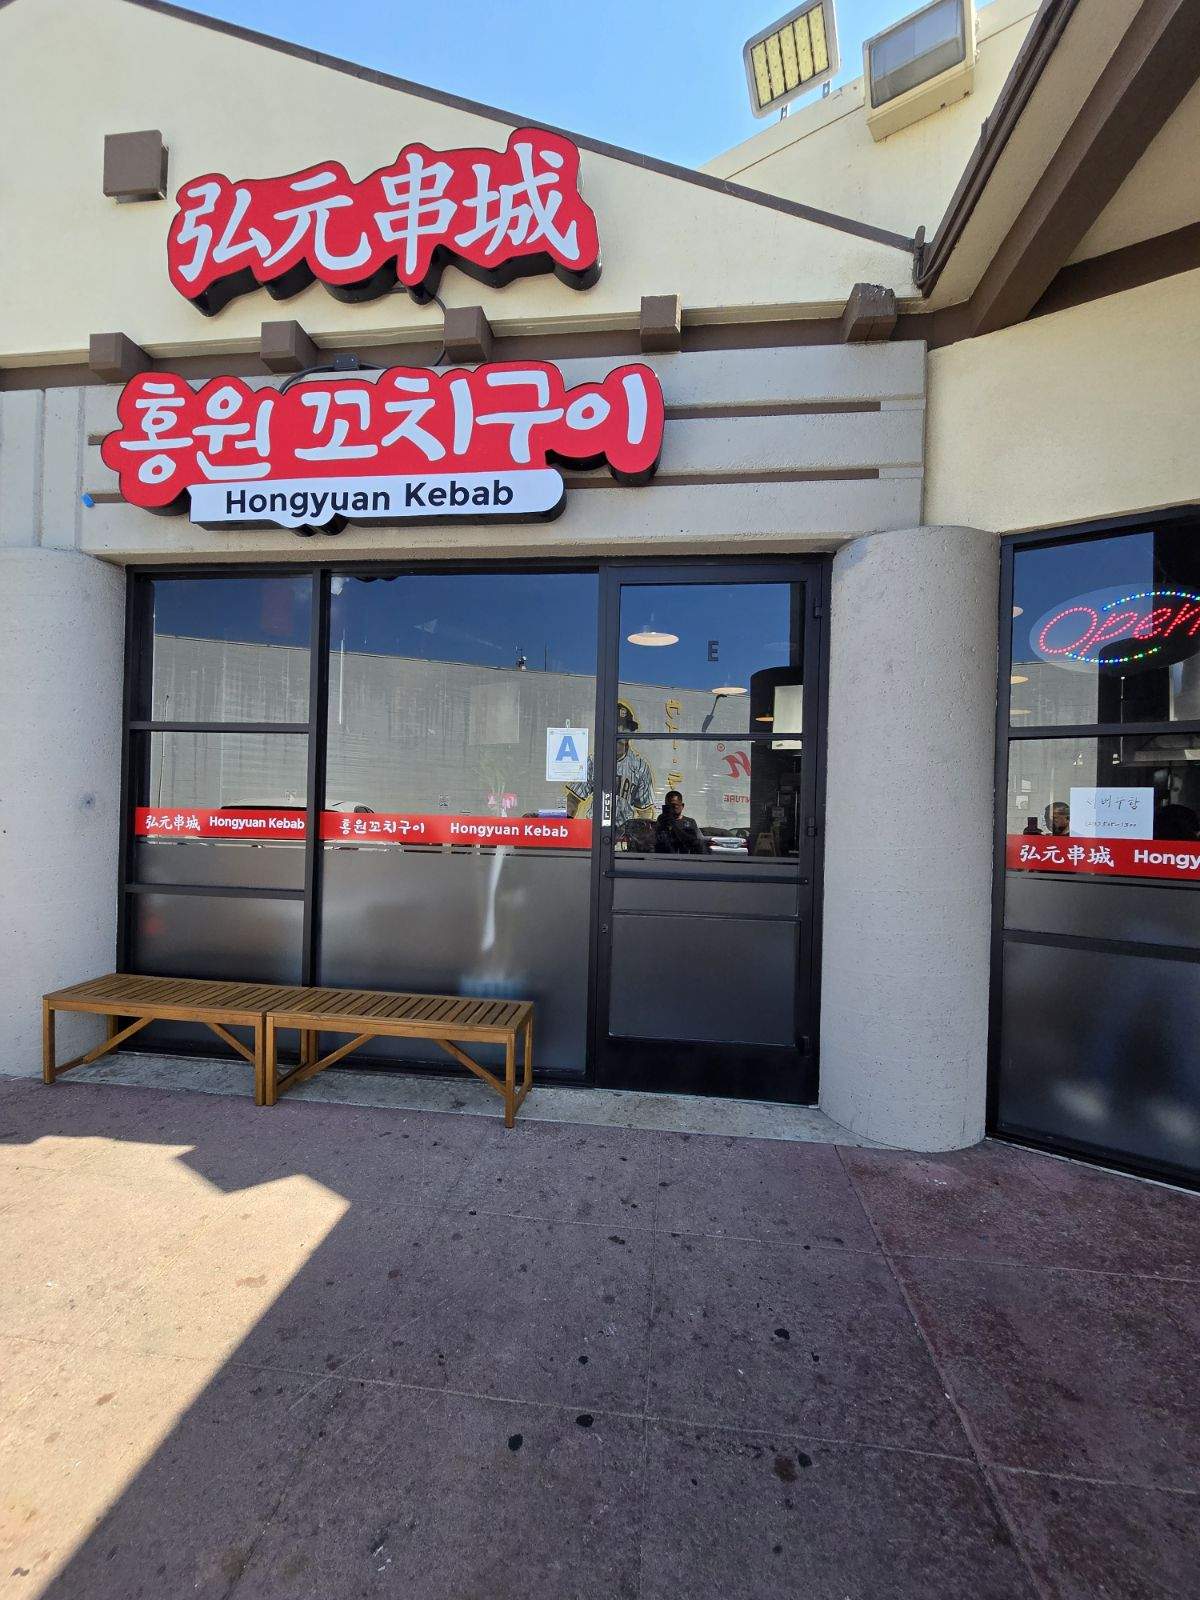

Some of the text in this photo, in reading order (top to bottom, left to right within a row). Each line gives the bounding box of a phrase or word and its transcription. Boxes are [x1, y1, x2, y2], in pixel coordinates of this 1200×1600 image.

[177, 142, 580, 283] 弘元串城
[226, 480, 514, 518] Hongyuan Kebab
[1039, 605, 1200, 657] Open
[707, 640, 720, 662] E
[556, 735, 580, 762] A
[146, 814, 200, 831] 弘元串城
[209, 816, 305, 830] Hongyuan Kebab
[450, 822, 569, 838] Hongyuan Kebab
[1020, 844, 1115, 867] 弘元串城
